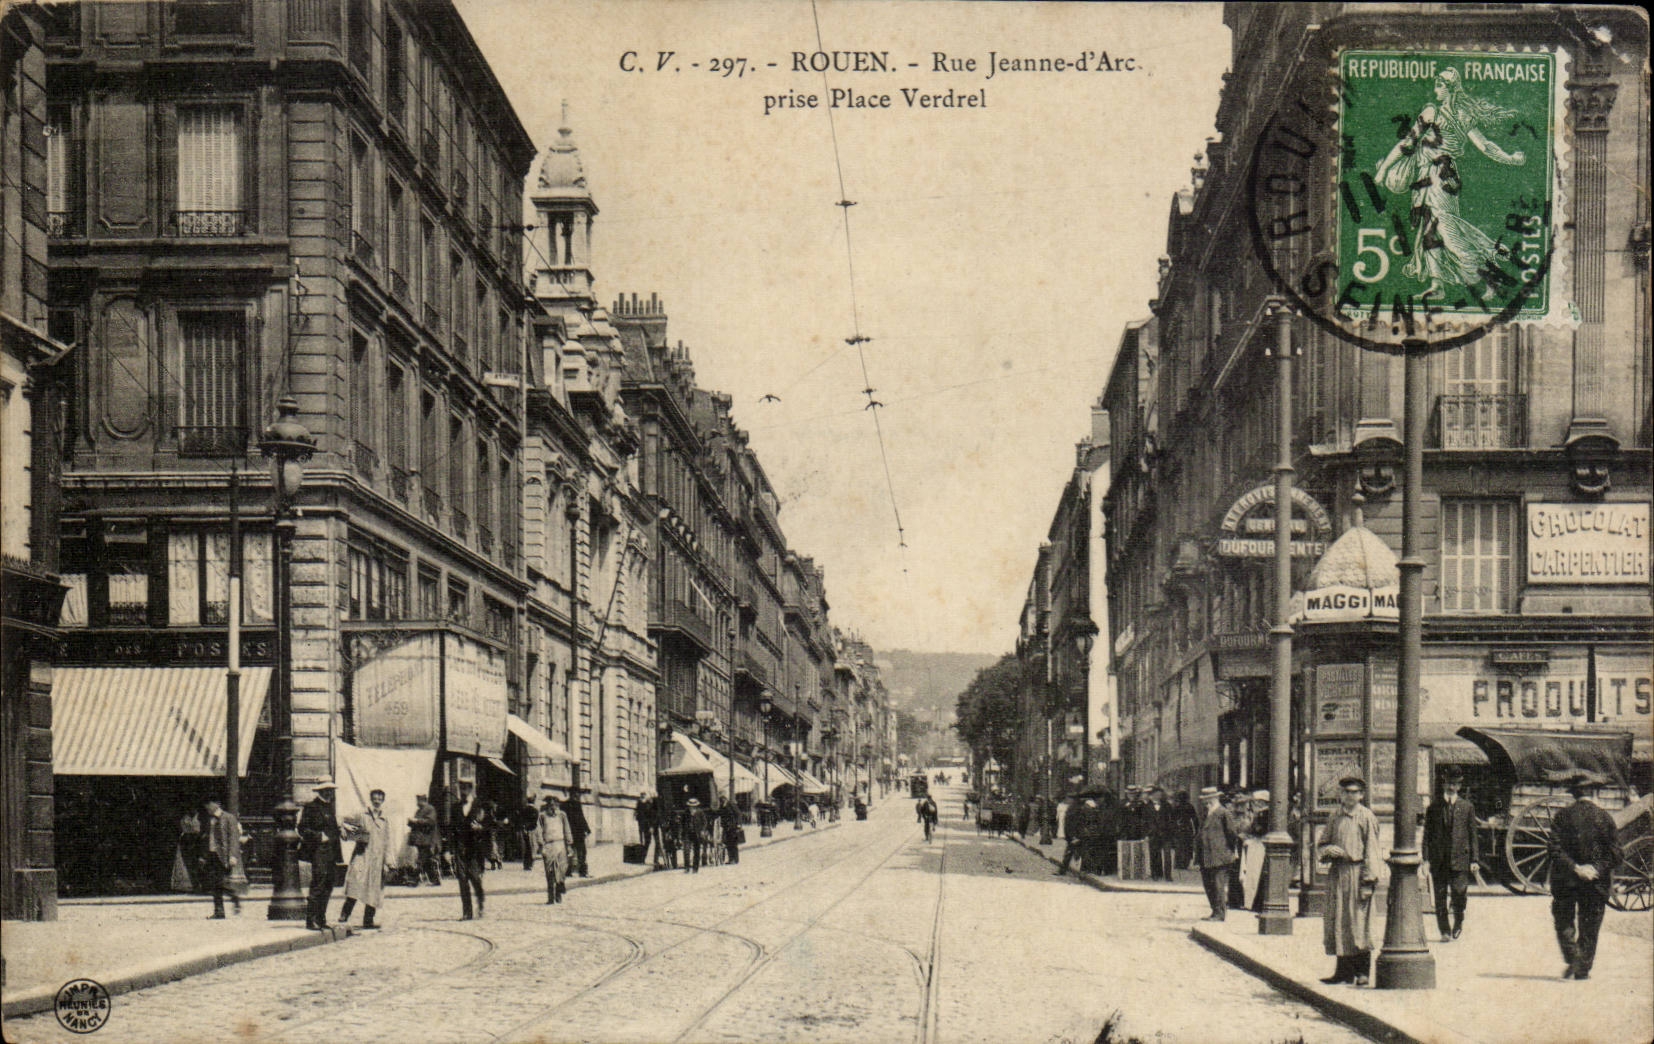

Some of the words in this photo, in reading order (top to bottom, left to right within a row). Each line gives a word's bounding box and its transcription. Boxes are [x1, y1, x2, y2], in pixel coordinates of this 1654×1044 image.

[1464, 61, 1547, 83] FRANÇAISE
[1530, 510, 1646, 539] CHOCOLAT
[1530, 550, 1644, 576] CARPENTIER
[1306, 593, 1368, 611] MAGGI
[1472, 677, 1650, 718] PRODUITS
